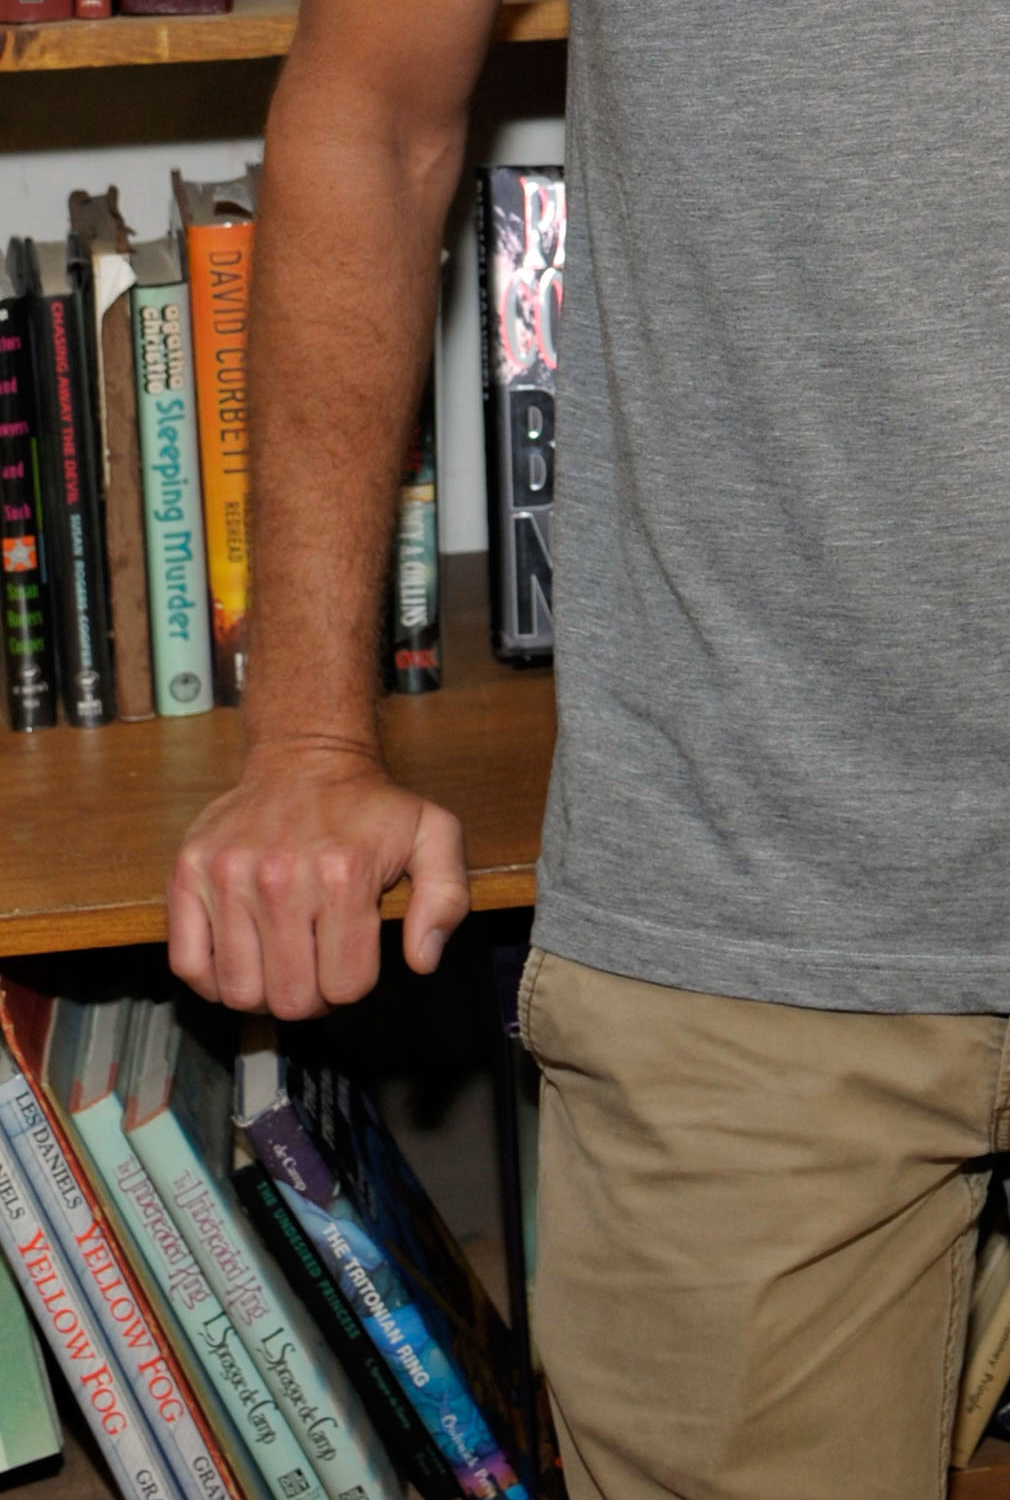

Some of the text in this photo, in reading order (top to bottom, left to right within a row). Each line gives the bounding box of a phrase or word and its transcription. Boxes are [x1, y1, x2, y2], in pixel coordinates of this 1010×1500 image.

[208, 249, 247, 336] DAVID
[141, 305, 168, 396] christie
[161, 304, 186, 391] agatha
[51, 300, 80, 506] CHASING AWAY THE DEVIL
[151, 397, 197, 642] Sleeping Murder
[15, 1091, 84, 1211] LES DANIELS
[256, 1179, 274, 1207] THE
[74, 1219, 186, 1424] YELLOW FOG
[167, 1261, 213, 1312] King
[224, 1274, 271, 1328] King
[321, 1222, 431, 1389] THE TRITONIAN RING
[17, 1227, 128, 1436] YELLOW FOG
[246, 1399, 281, 1445] Camp
[307, 1415, 339, 1462] Camp
